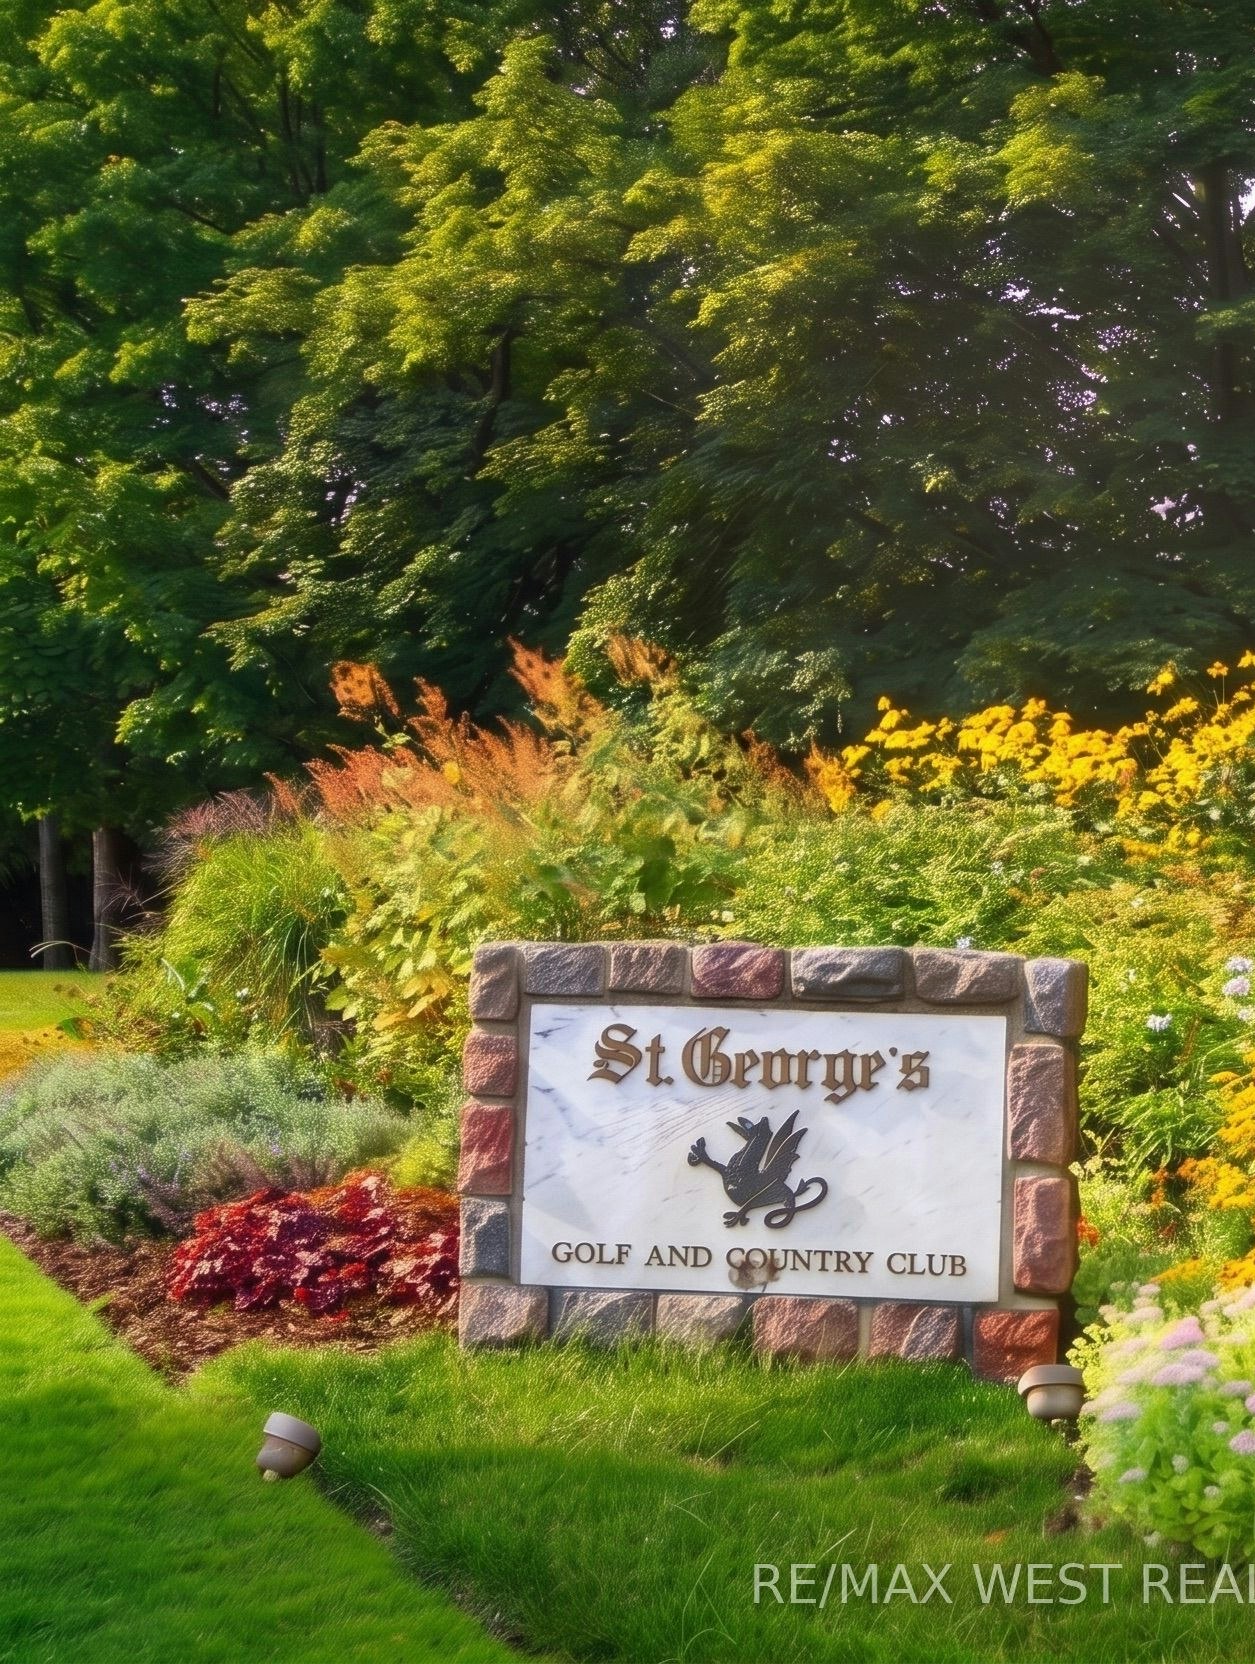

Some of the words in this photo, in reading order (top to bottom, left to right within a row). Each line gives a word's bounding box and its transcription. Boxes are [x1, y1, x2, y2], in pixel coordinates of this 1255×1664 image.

[587, 1023, 674, 1087] St.
[681, 1025, 930, 1104] George's
[551, 1241, 632, 1266] GOLF
[645, 1244, 713, 1268] AND
[726, 1246, 874, 1275] COUNTRY
[886, 1251, 968, 1278] CLUB
